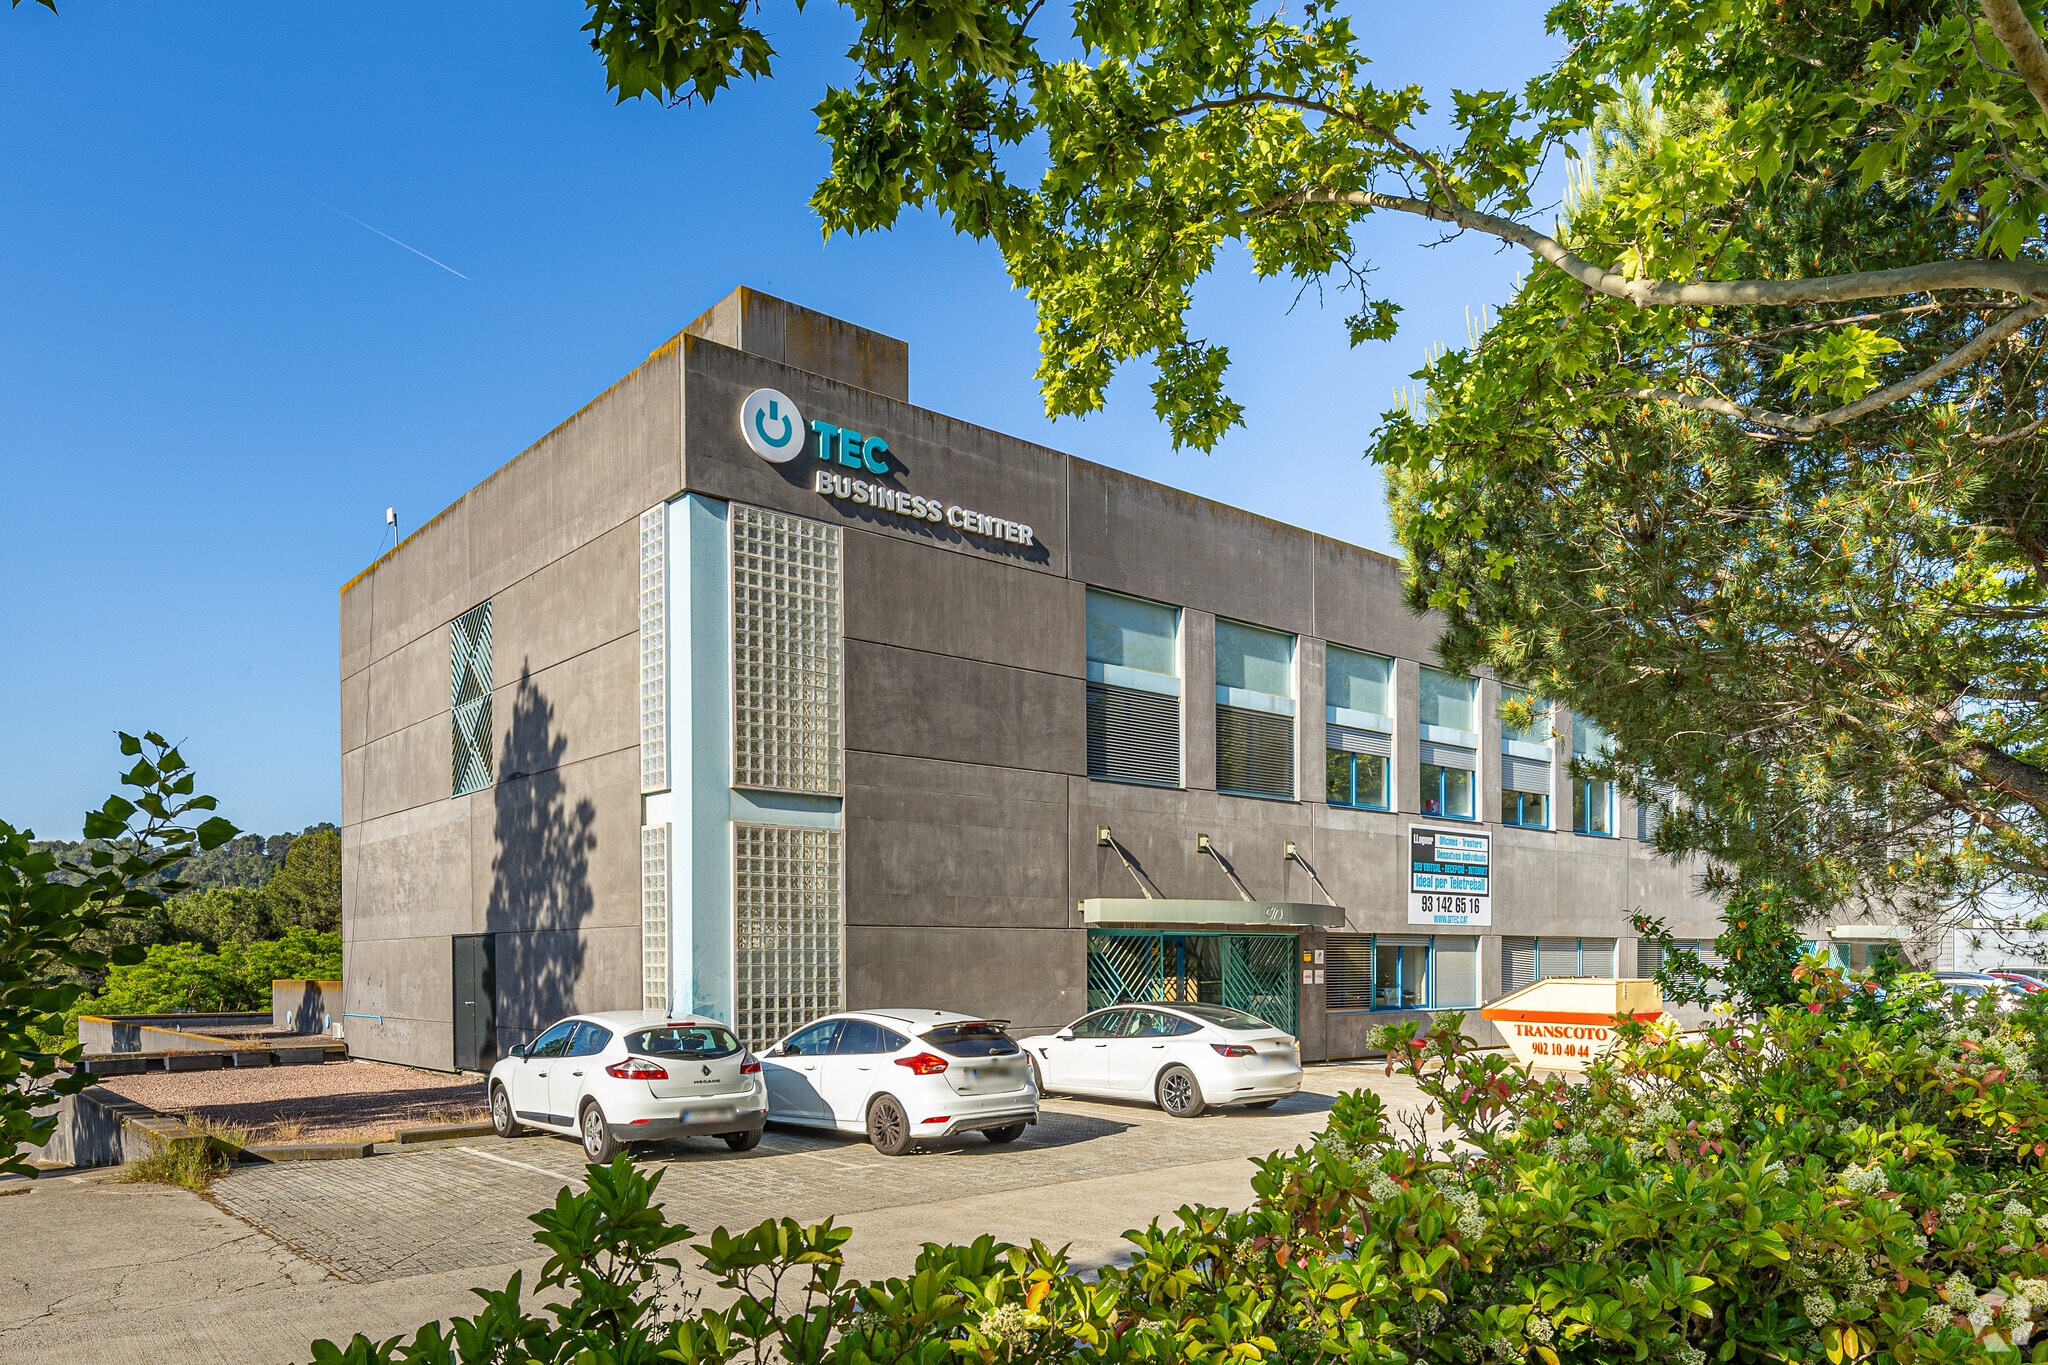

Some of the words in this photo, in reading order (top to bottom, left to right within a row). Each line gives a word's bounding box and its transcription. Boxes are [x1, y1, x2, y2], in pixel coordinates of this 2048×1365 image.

[811, 419, 889, 475] TEC
[815, 469, 943, 523] BUSINESS
[947, 505, 1034, 547] CENTER
[1439, 836, 1458, 847] Oficines
[1462, 838, 1483, 849] Trasters
[1413, 861, 1422, 871] SEU
[1423, 863, 1441, 872] VIRTUAL
[1468, 865, 1488, 876] INTERNET
[1415, 875, 1433, 888] Ideal
[1435, 877, 1448, 890] per
[1450, 876, 1486, 891] Teletreball
[1421, 895, 1433, 912] 93
[1436, 896, 1453, 913] 142
[1455, 897, 1467, 914] 65
[1469, 898, 1480, 914] 16
[1513, 1024, 1608, 1041] TRANSCOTO
[1532, 1042, 1548, 1056] 902
[1551, 1043, 1562, 1056] 10
[1564, 1043, 1575, 1057] 40
[1577, 1045, 1589, 1058] 44
